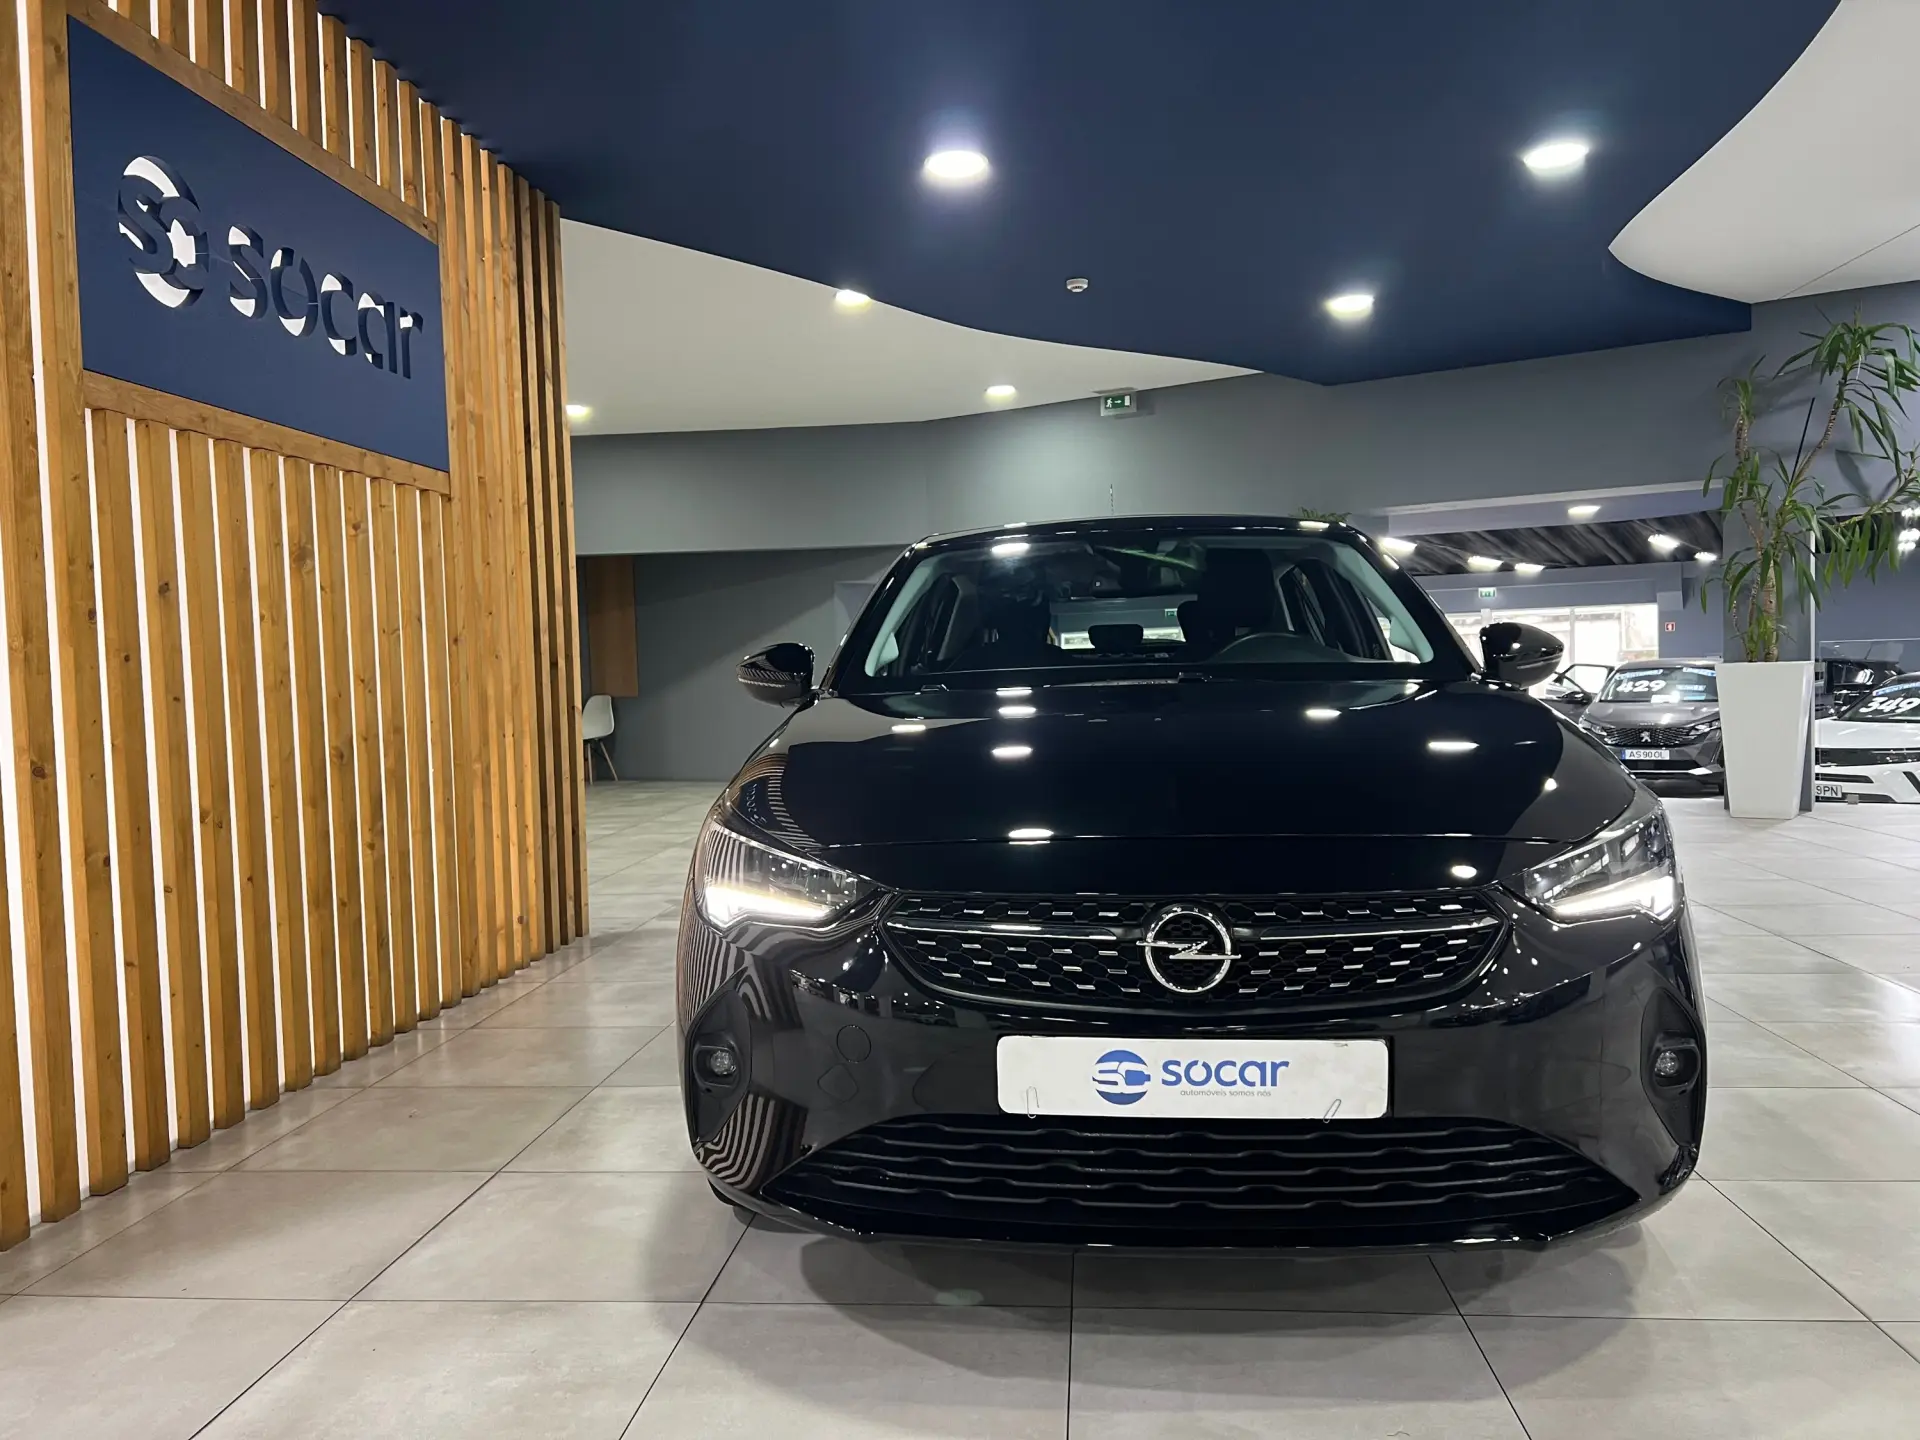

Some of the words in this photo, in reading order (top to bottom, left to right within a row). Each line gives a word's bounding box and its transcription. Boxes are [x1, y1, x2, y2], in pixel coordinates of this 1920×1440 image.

[1616, 679, 1667, 693] 429
[1858, 696, 1920, 713] 349
[1628, 750, 1642, 759] AS
[1642, 750, 1653, 759] 90
[1161, 1059, 1290, 1088] socar
[1179, 1088, 1227, 1097] automóveis
[1256, 1088, 1272, 1097] nós
